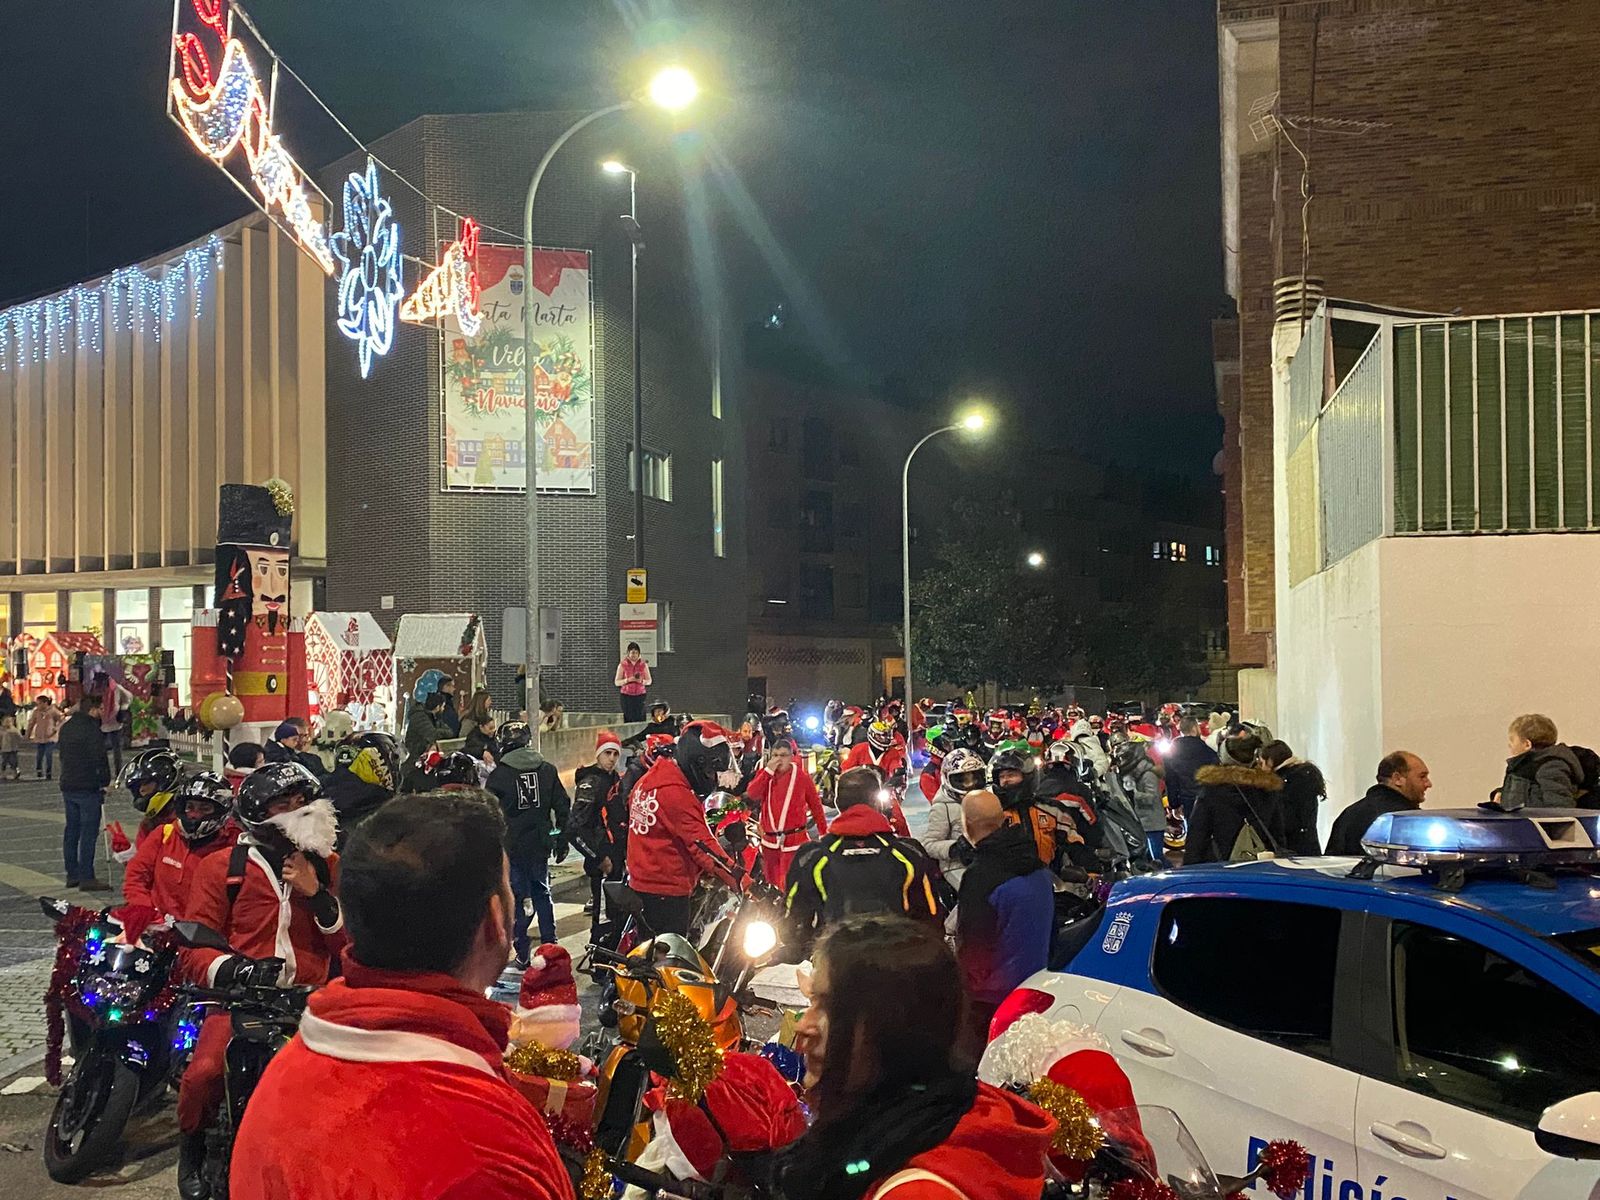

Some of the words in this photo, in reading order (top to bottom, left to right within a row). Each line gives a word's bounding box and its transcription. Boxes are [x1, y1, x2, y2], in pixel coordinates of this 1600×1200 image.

[492, 344, 545, 367] Vil
[476, 388, 560, 413] Naviña
[1247, 1136, 1407, 1200] Plic
